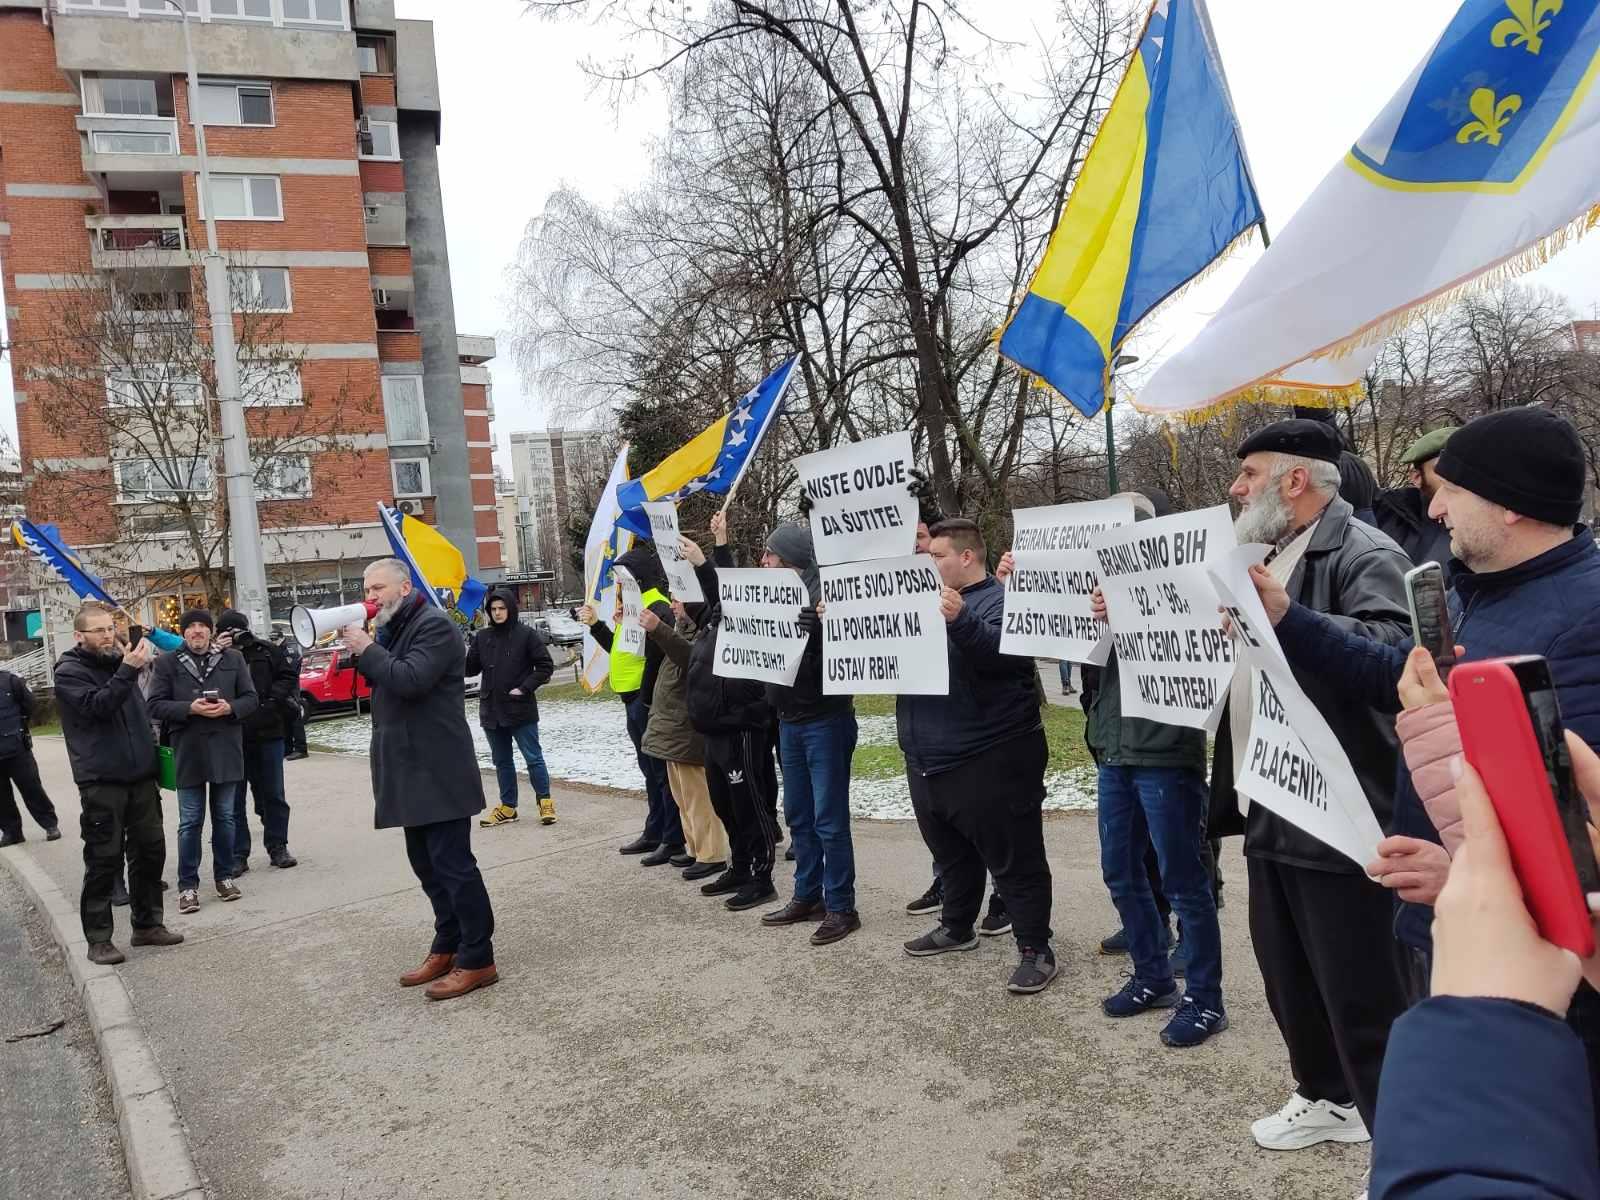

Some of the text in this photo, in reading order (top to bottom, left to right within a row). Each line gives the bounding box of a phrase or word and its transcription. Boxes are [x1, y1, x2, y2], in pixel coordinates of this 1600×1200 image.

[807, 460, 905, 499] NISTE OVDJE
[821, 505, 903, 536] DA ŠUTITE!
[1014, 527, 1059, 551] NEGIRANJE
[1097, 529, 1207, 577] BRANILI SMO BIH
[722, 584, 732, 601] DA
[735, 584, 742, 602] LI
[745, 585, 760, 602] STE
[823, 568, 941, 603] RADITE SVOJ POSAO,
[1008, 570, 1060, 594] NEGIRANJE
[1061, 571, 1067, 594] I
[724, 616, 736, 632] DA
[736, 615, 776, 637] UNIŠTITE
[778, 620, 793, 639] ILI
[827, 612, 921, 642] ILI POVRATAK NA
[1006, 608, 1045, 635] ZAŠTO
[1048, 614, 1073, 638] NEMA
[722, 643, 785, 671] ČUVATE BIH?!
[1148, 624, 1181, 662] ĆEMO
[1185, 629, 1199, 663] JE
[828, 656, 899, 681] USTAV RBIH!
[1138, 675, 1217, 710] AKO ZATREBA!
[1251, 737, 1327, 811] PLAĆENI?!
